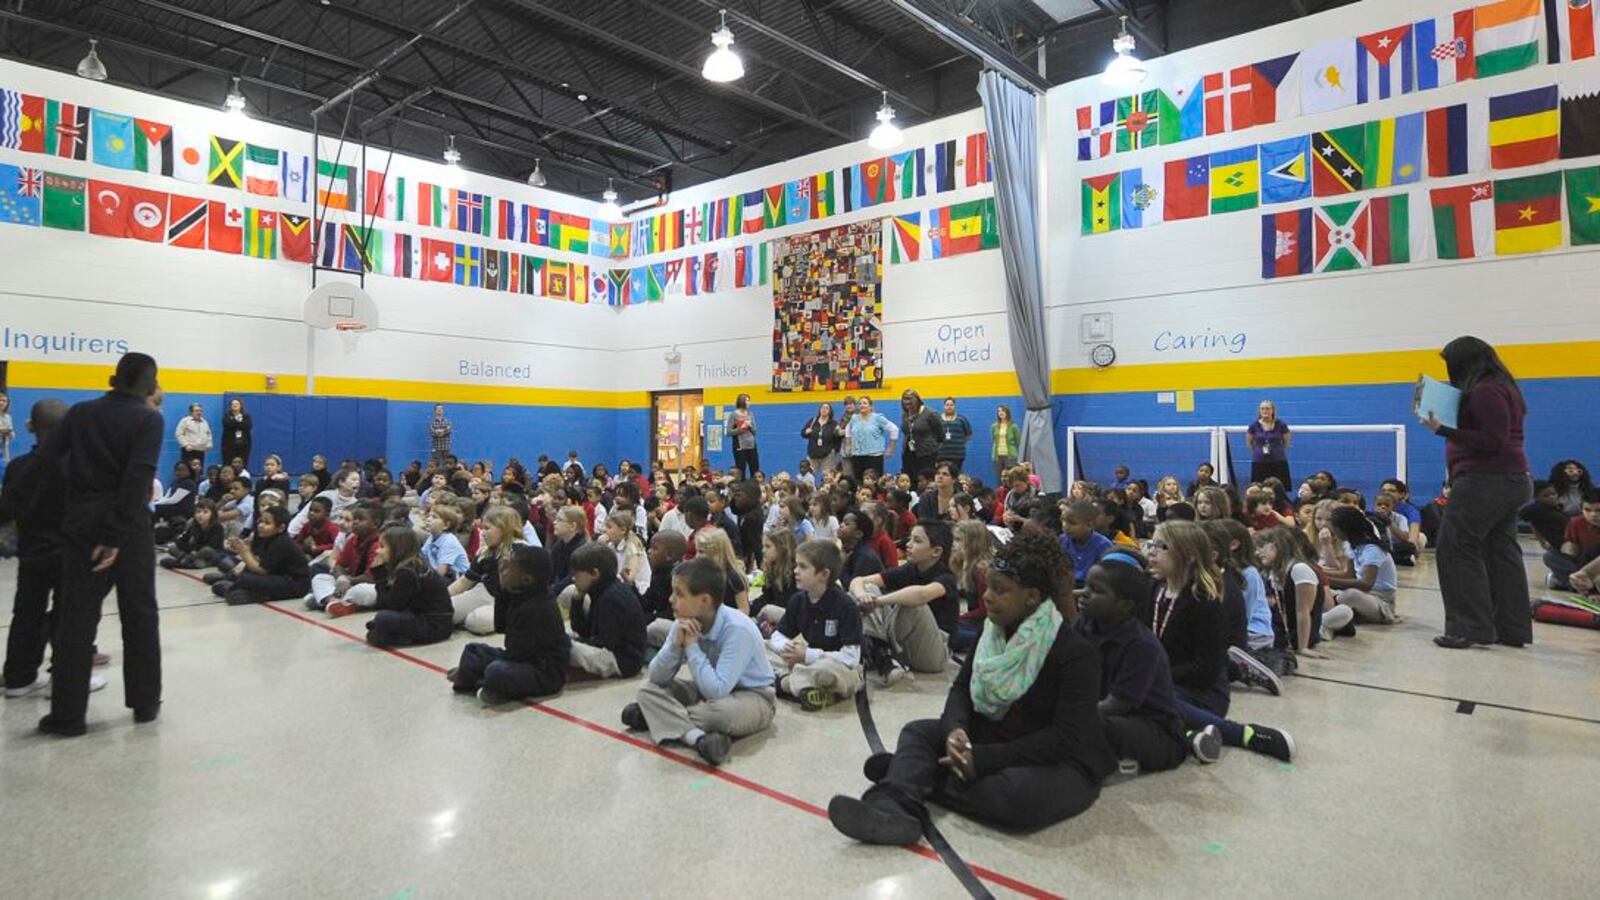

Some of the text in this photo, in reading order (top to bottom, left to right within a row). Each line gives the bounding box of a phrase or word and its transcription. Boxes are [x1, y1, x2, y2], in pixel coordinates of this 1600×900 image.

[4, 327, 129, 355] Inquirers
[937, 324, 985, 346] Open
[1153, 326, 1247, 353] Caring
[925, 343, 991, 365] Minded
[459, 359, 531, 379] Balanced
[695, 361, 749, 379] Thinkers
